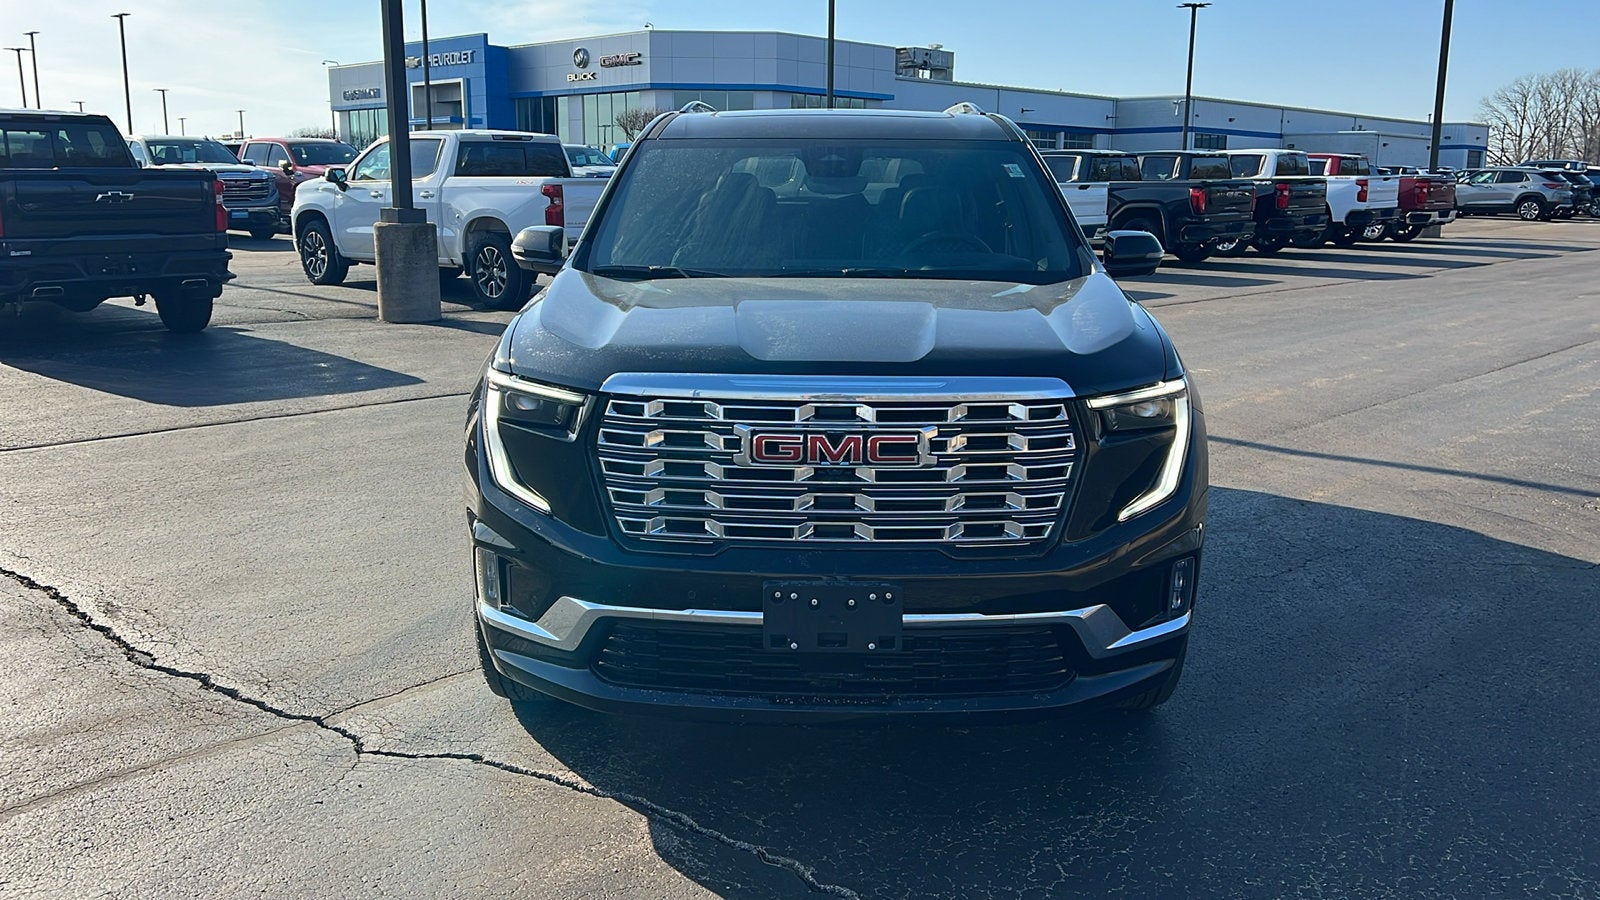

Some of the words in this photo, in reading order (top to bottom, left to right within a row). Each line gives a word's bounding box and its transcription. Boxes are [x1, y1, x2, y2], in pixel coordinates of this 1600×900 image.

[600, 52, 641, 68] GMC
[567, 72, 595, 81] BUICK
[753, 434, 918, 463] GMC
